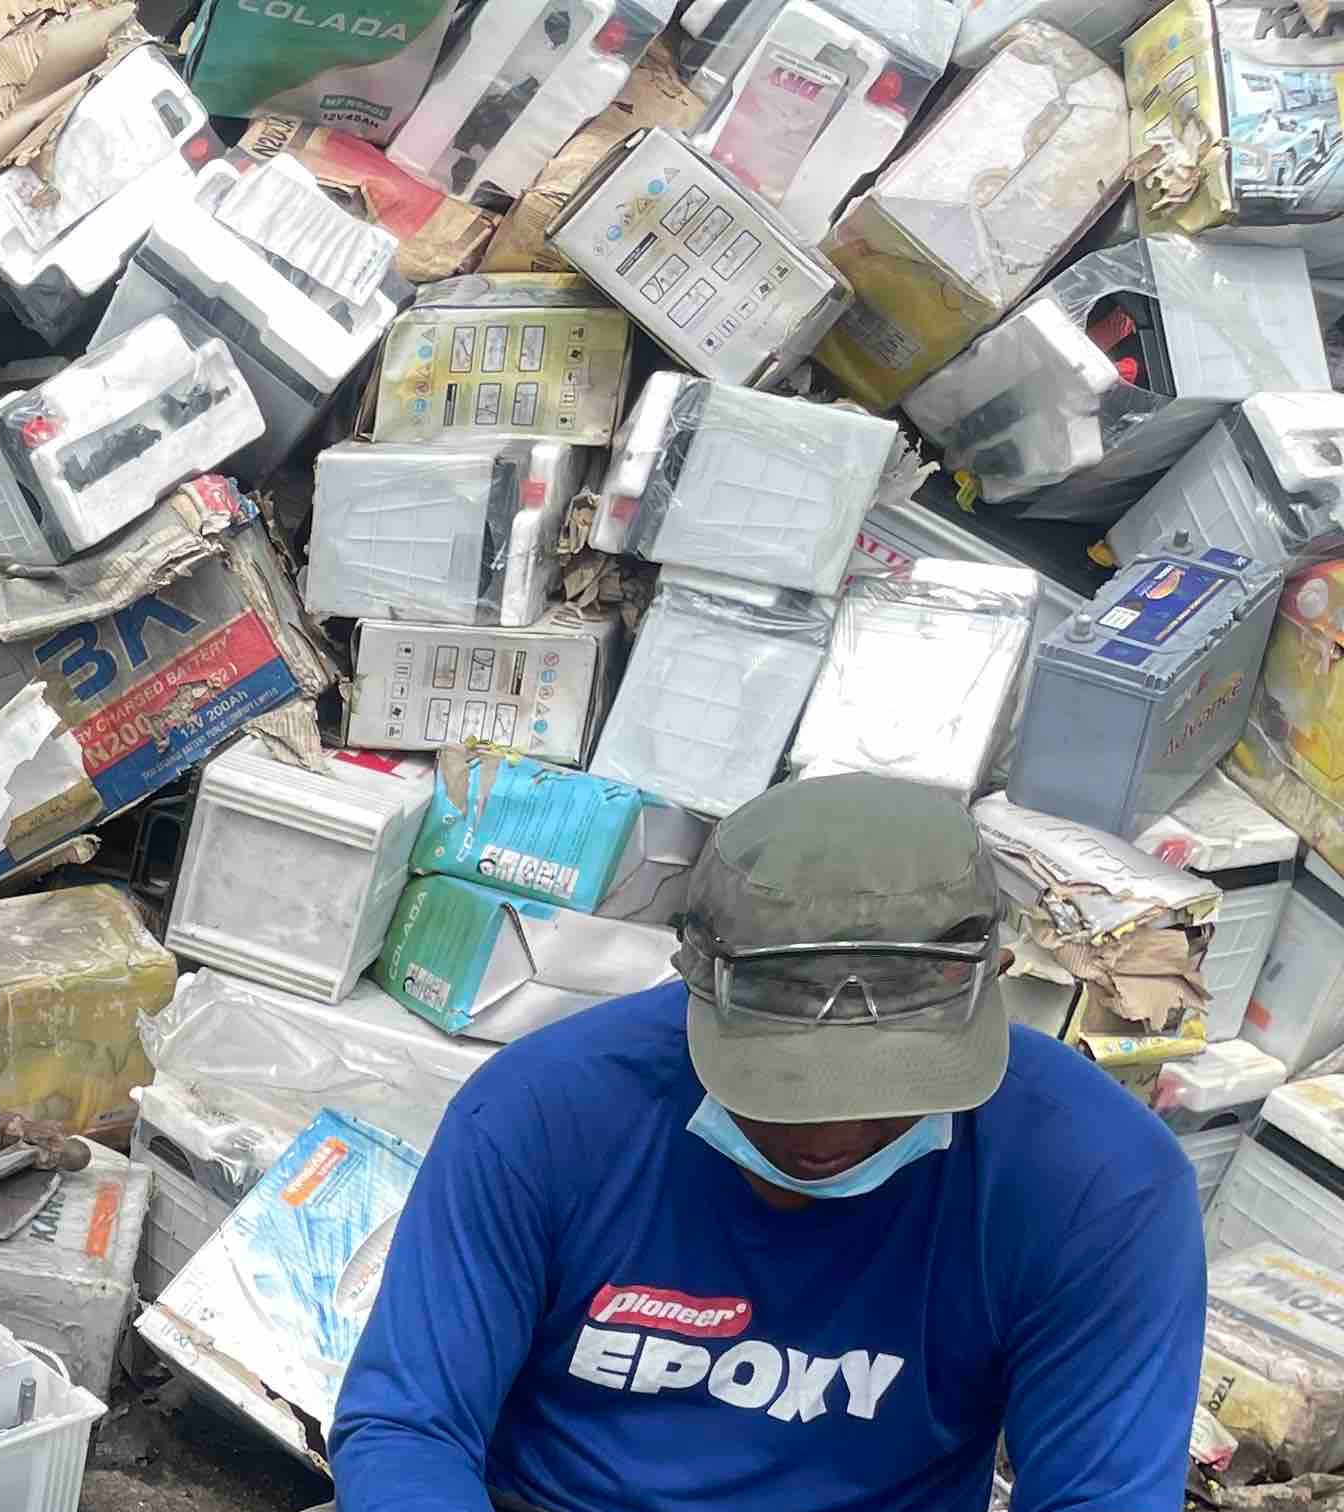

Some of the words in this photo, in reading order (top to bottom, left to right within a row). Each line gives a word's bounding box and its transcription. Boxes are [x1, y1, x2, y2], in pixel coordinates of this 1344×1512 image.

[166, 633, 230, 686] BATTERY
[388, 891, 428, 982] COLADA
[568, 1324, 905, 1424] EPOXY
